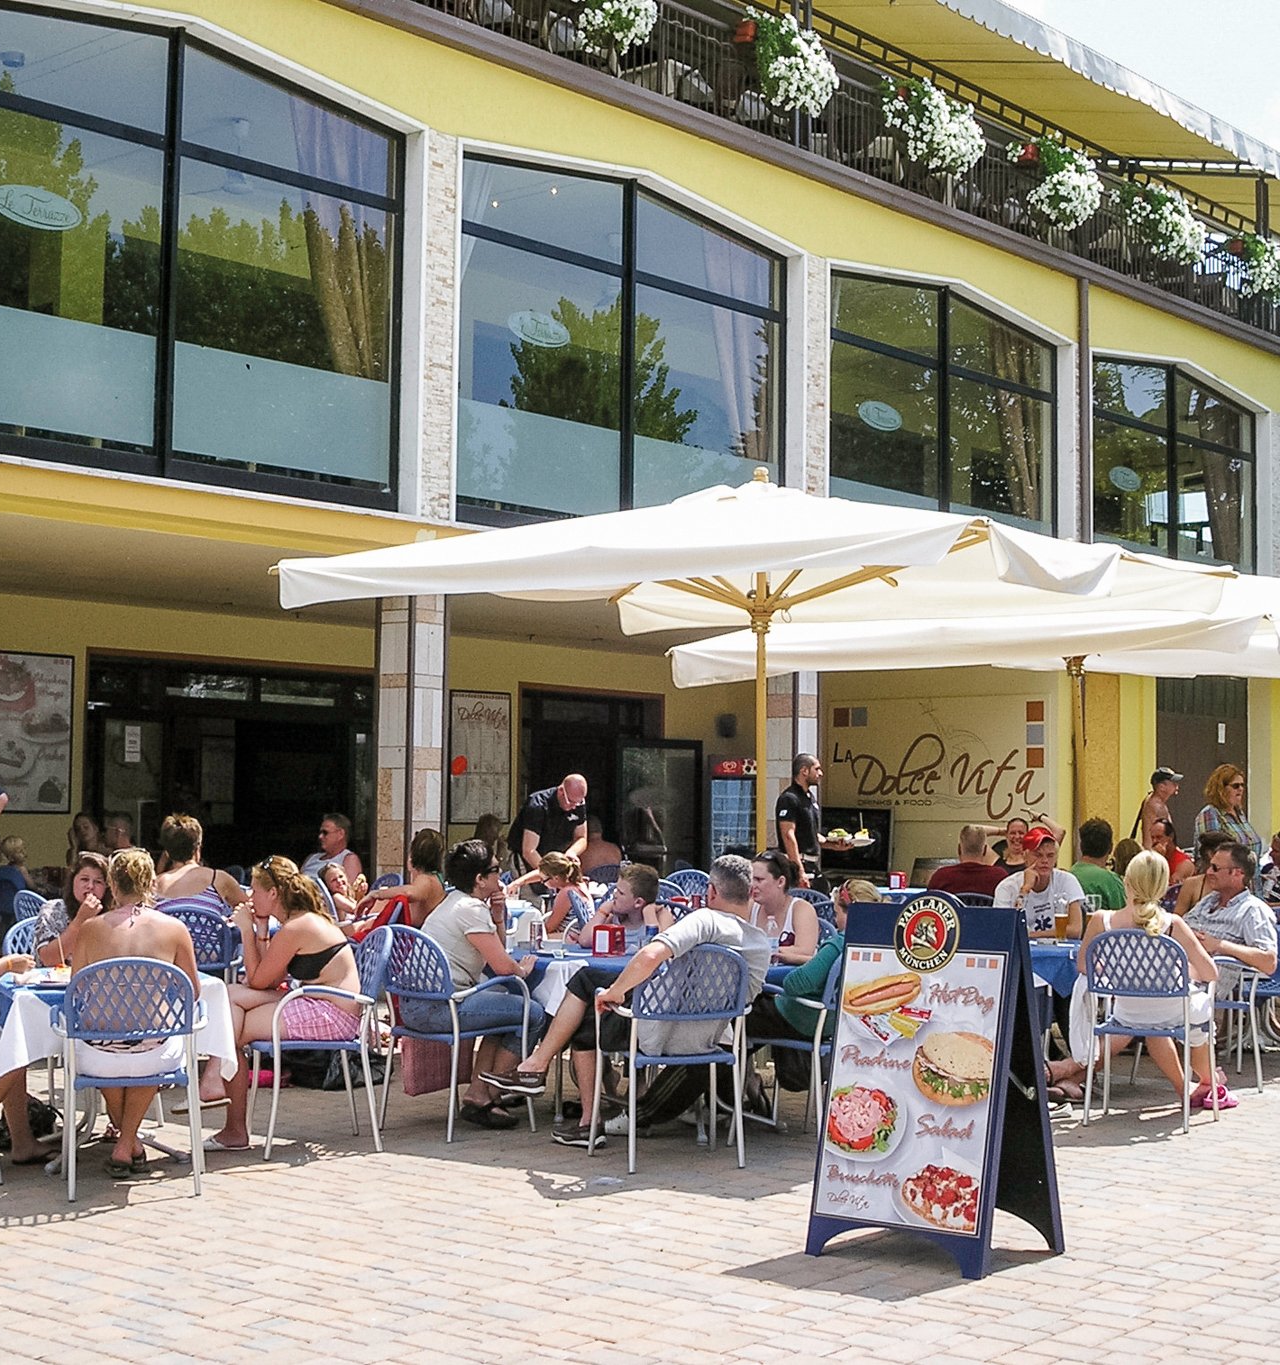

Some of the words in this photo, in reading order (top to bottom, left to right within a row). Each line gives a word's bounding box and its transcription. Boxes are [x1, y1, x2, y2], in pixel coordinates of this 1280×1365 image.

[851, 733, 945, 796] Dolce
[950, 749, 1045, 820] Vita
[897, 899, 956, 931] PAULANER
[915, 1113, 975, 1140] Salad
